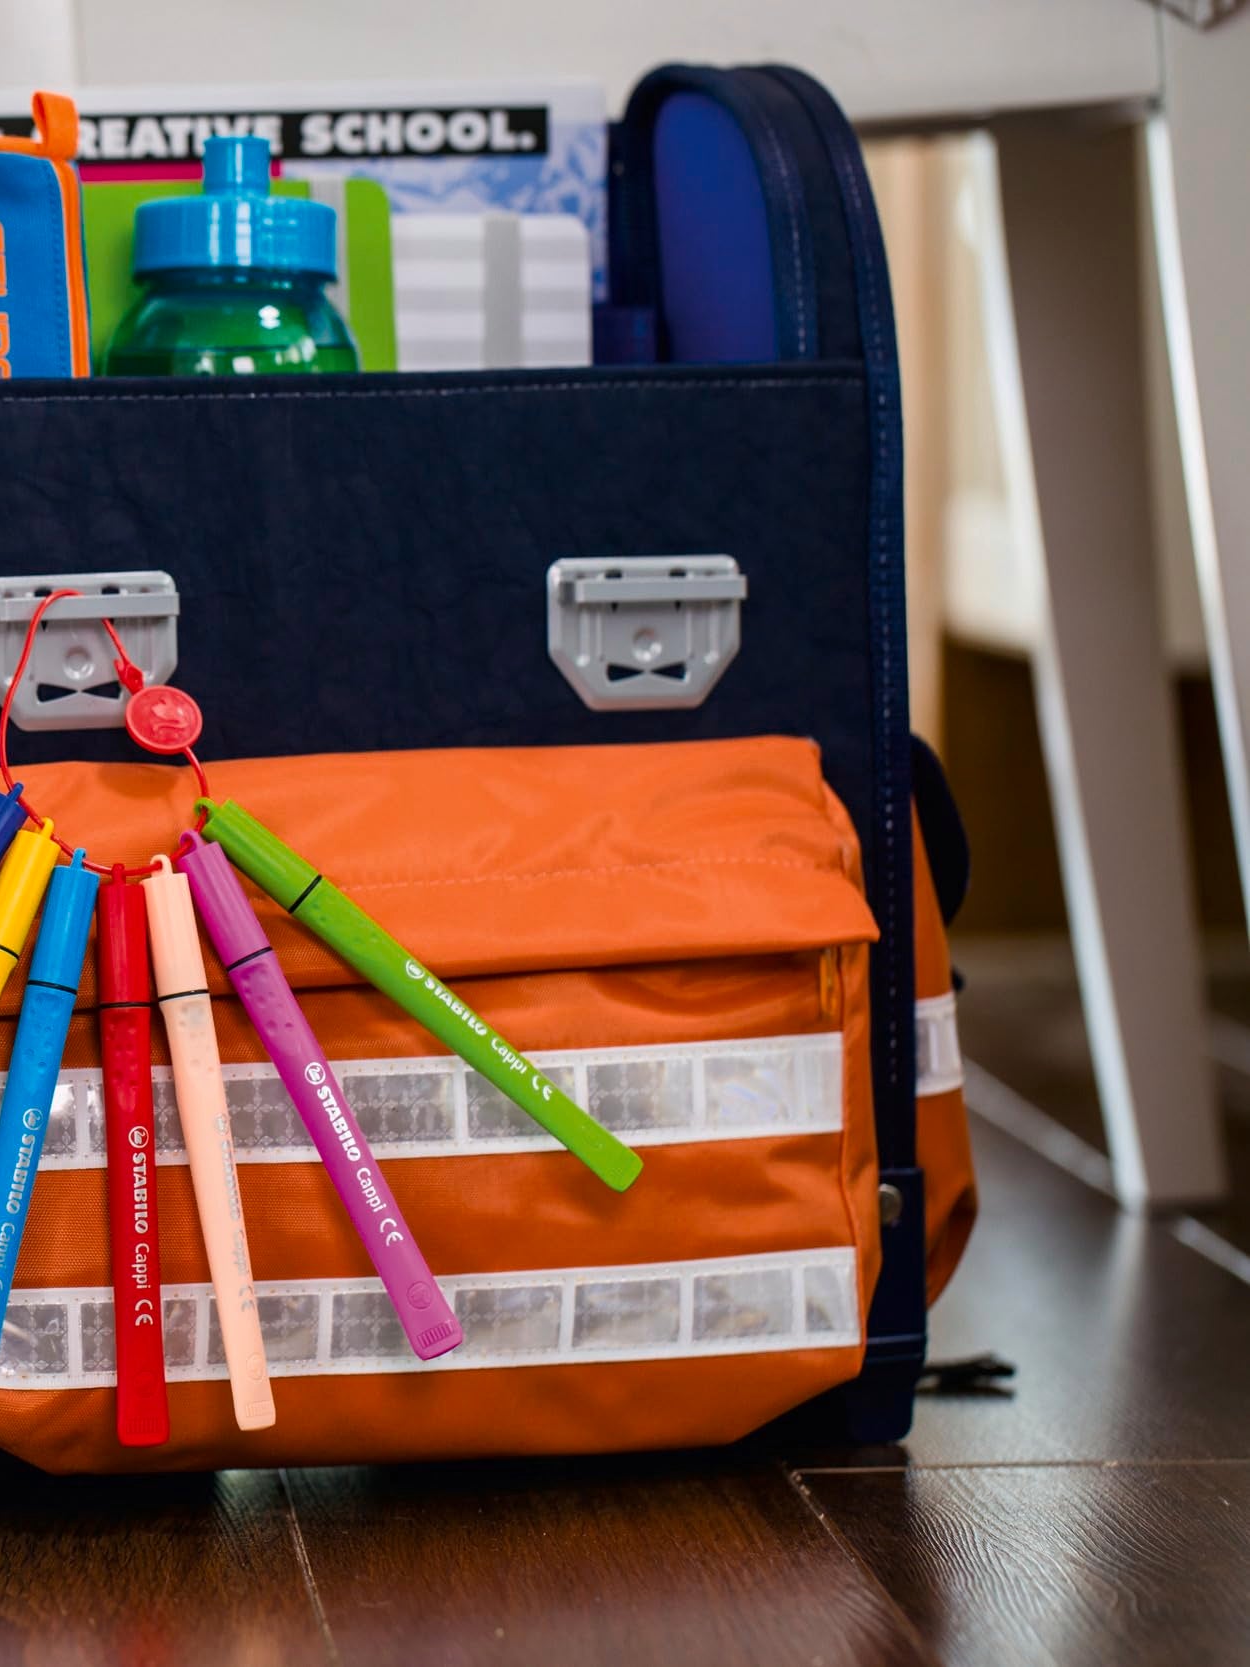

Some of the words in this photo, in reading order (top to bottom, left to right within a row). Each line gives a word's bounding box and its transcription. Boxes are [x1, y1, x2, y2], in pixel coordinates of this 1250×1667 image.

[78, 112, 283, 160] REATIVE
[301, 108, 537, 155] SCHOOL.
[424, 976, 487, 1036] STABILO
[491, 1037, 527, 1074] Cappi
[6, 1133, 36, 1215] STABILO
[317, 1085, 361, 1162] STABILO
[356, 1167, 387, 1213] Cappi
[132, 1152, 149, 1235] STABILO
[131, 1242, 152, 1289] Cappi
